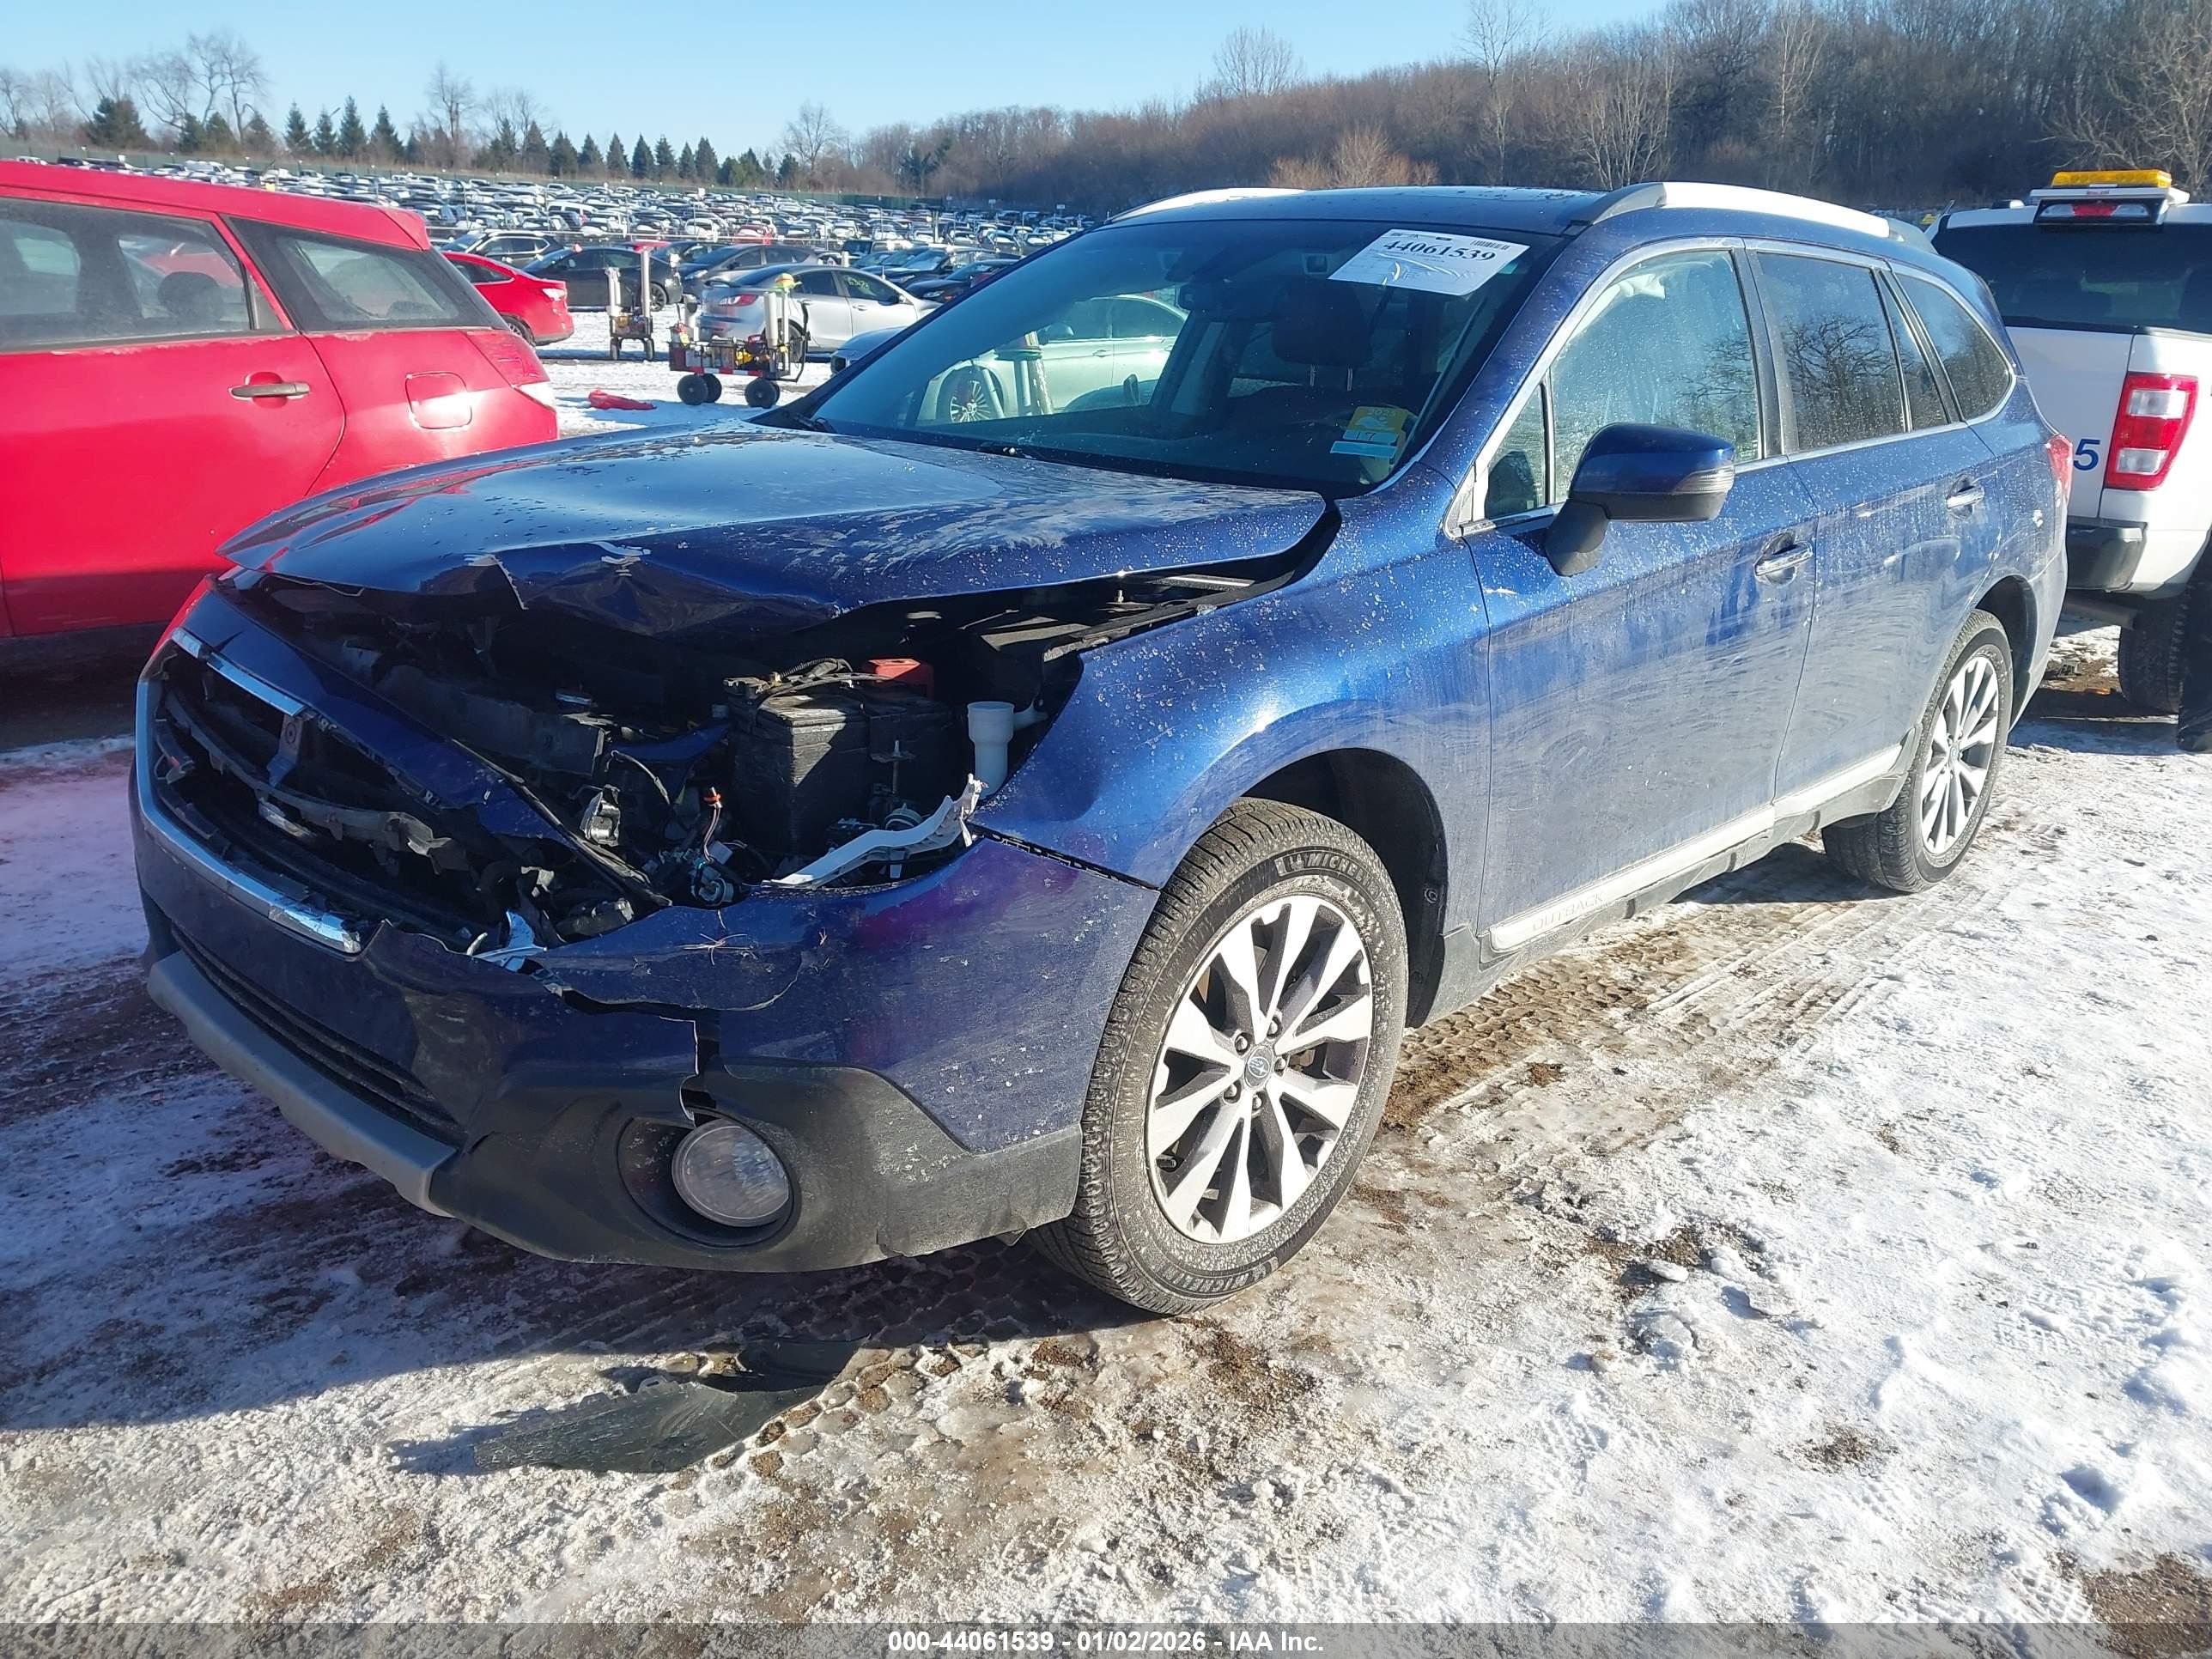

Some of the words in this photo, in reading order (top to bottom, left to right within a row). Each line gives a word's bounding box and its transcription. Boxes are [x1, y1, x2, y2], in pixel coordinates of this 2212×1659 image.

[1384, 240, 1496, 260] 44061539
[2073, 438, 2100, 471] 5
[1532, 892, 1604, 930] OUTBACK
